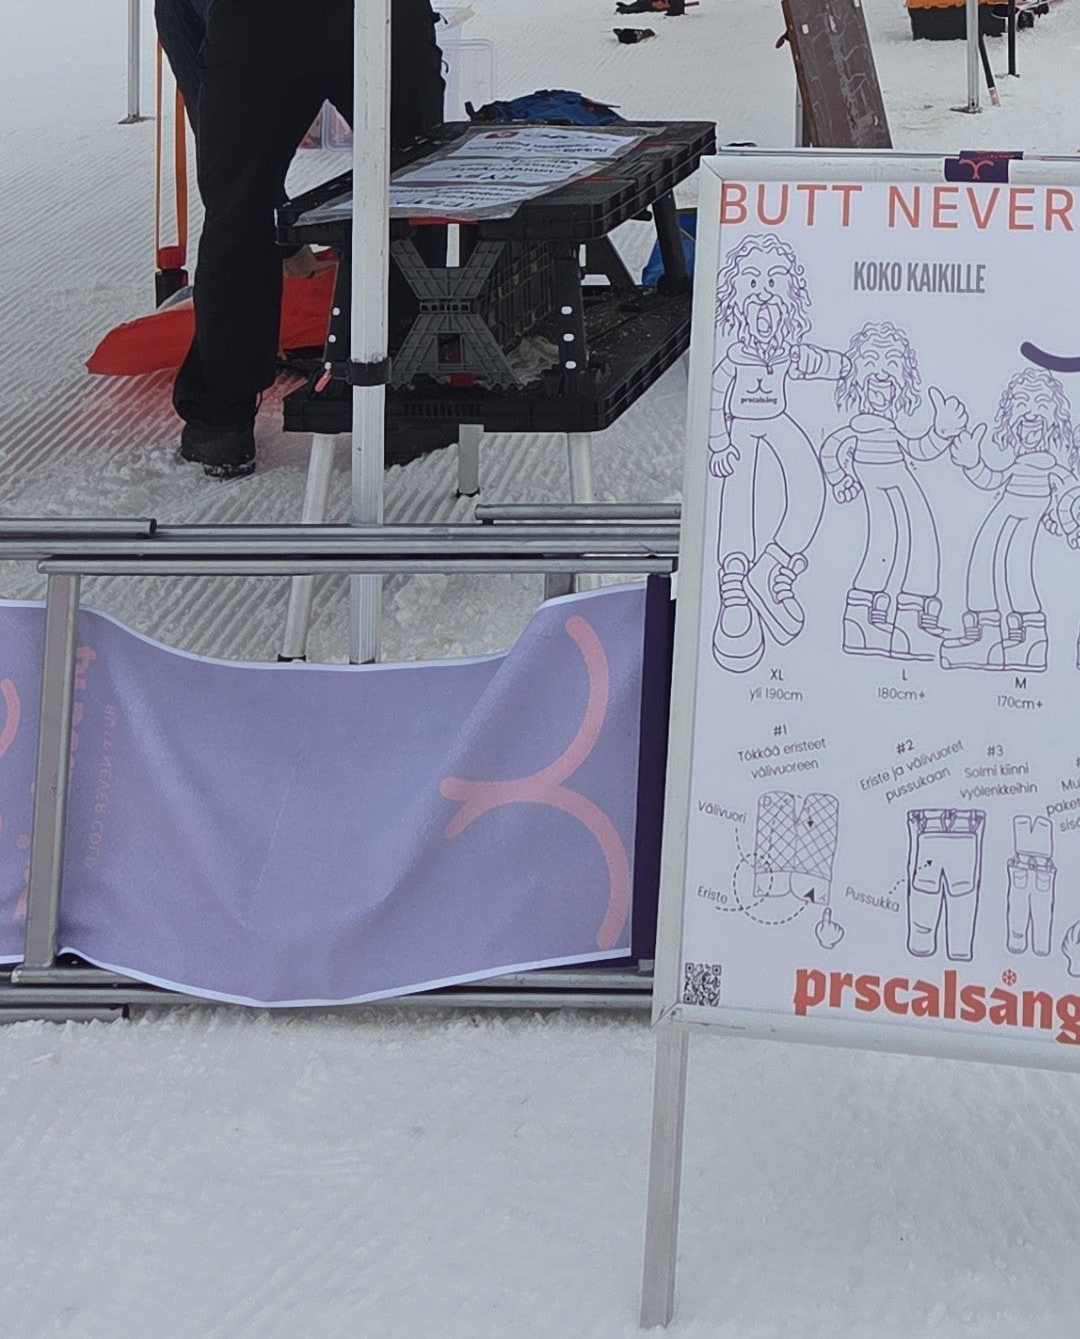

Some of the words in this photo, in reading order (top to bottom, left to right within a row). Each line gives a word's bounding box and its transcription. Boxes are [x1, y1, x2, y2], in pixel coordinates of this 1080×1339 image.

[720, 183, 862, 227] BUTT
[888, 185, 1075, 231] NEVER
[853, 261, 901, 291] KOKO
[906, 262, 986, 293] KAIKILLE
[770, 668, 784, 681] XL
[902, 668, 908, 681] L
[1014, 677, 1027, 689] M
[765, 687, 803, 701] 190cm
[877, 686, 926, 700] 180cm+
[997, 695, 1044, 710] 170cm+
[773, 724, 788, 736] #1
[783, 738, 827, 755] eristeet
[896, 739, 915, 754] #2
[986, 744, 1005, 758] #3
[859, 771, 891, 791] Eriste
[885, 766, 951, 804] pussukaan
[845, 885, 901, 913] Pussukka
